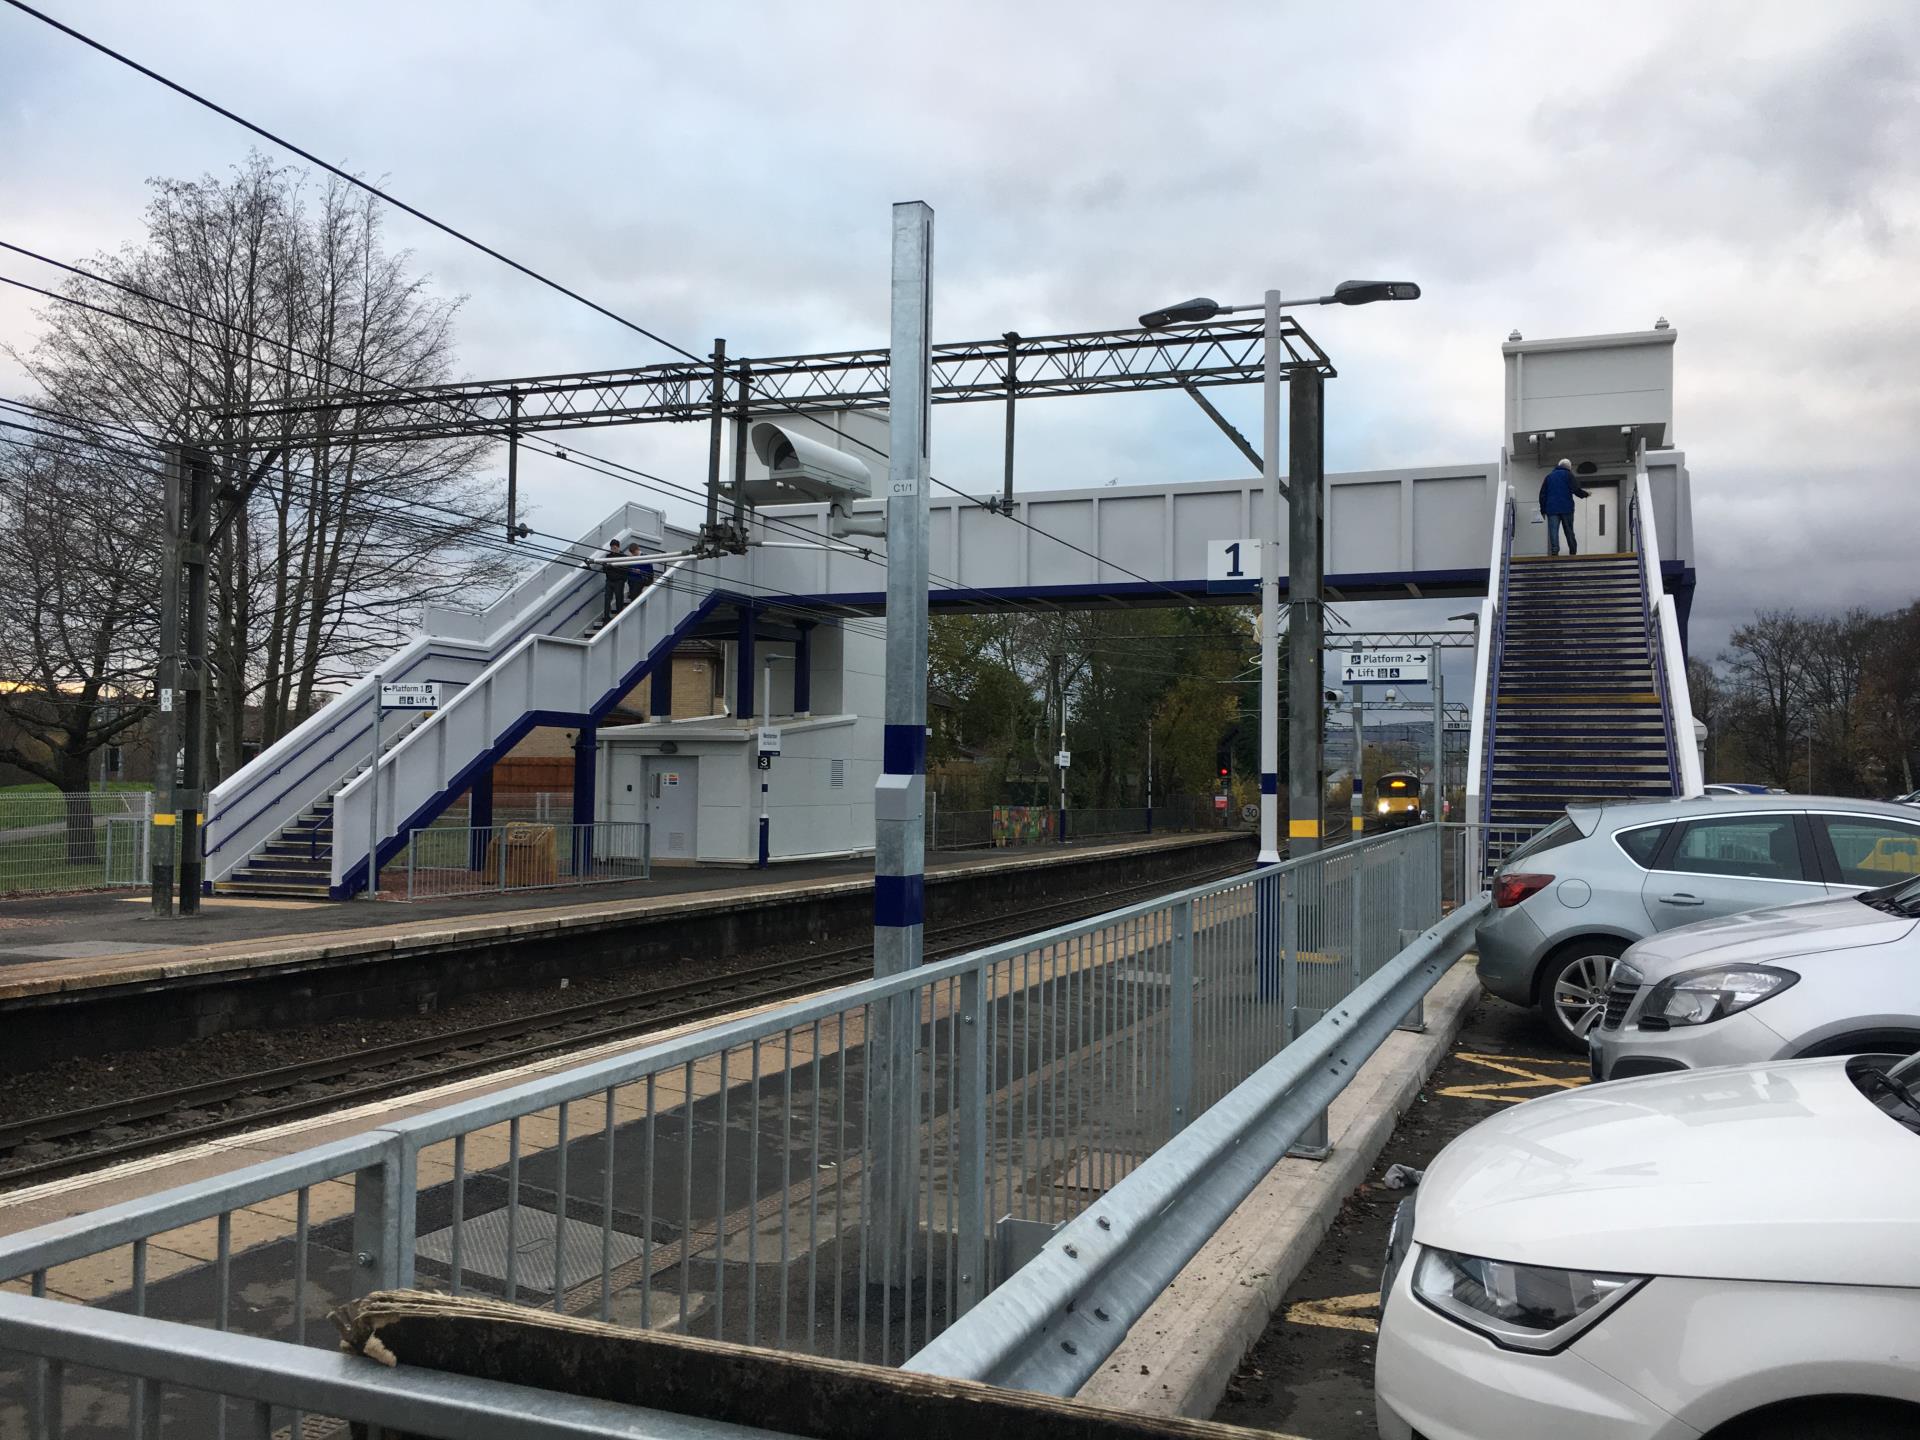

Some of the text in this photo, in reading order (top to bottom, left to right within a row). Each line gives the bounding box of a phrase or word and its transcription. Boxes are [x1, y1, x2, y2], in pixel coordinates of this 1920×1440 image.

[893, 483, 912, 493] C1/1
[1225, 543, 1243, 576] 1
[1363, 654, 1412, 664] Platform 2
[1357, 668, 1375, 677] Lift
[392, 684, 419, 692] Platform
[415, 695, 428, 704] Lift
[760, 757, 768, 766] 3
[1245, 807, 1257, 817] 30
